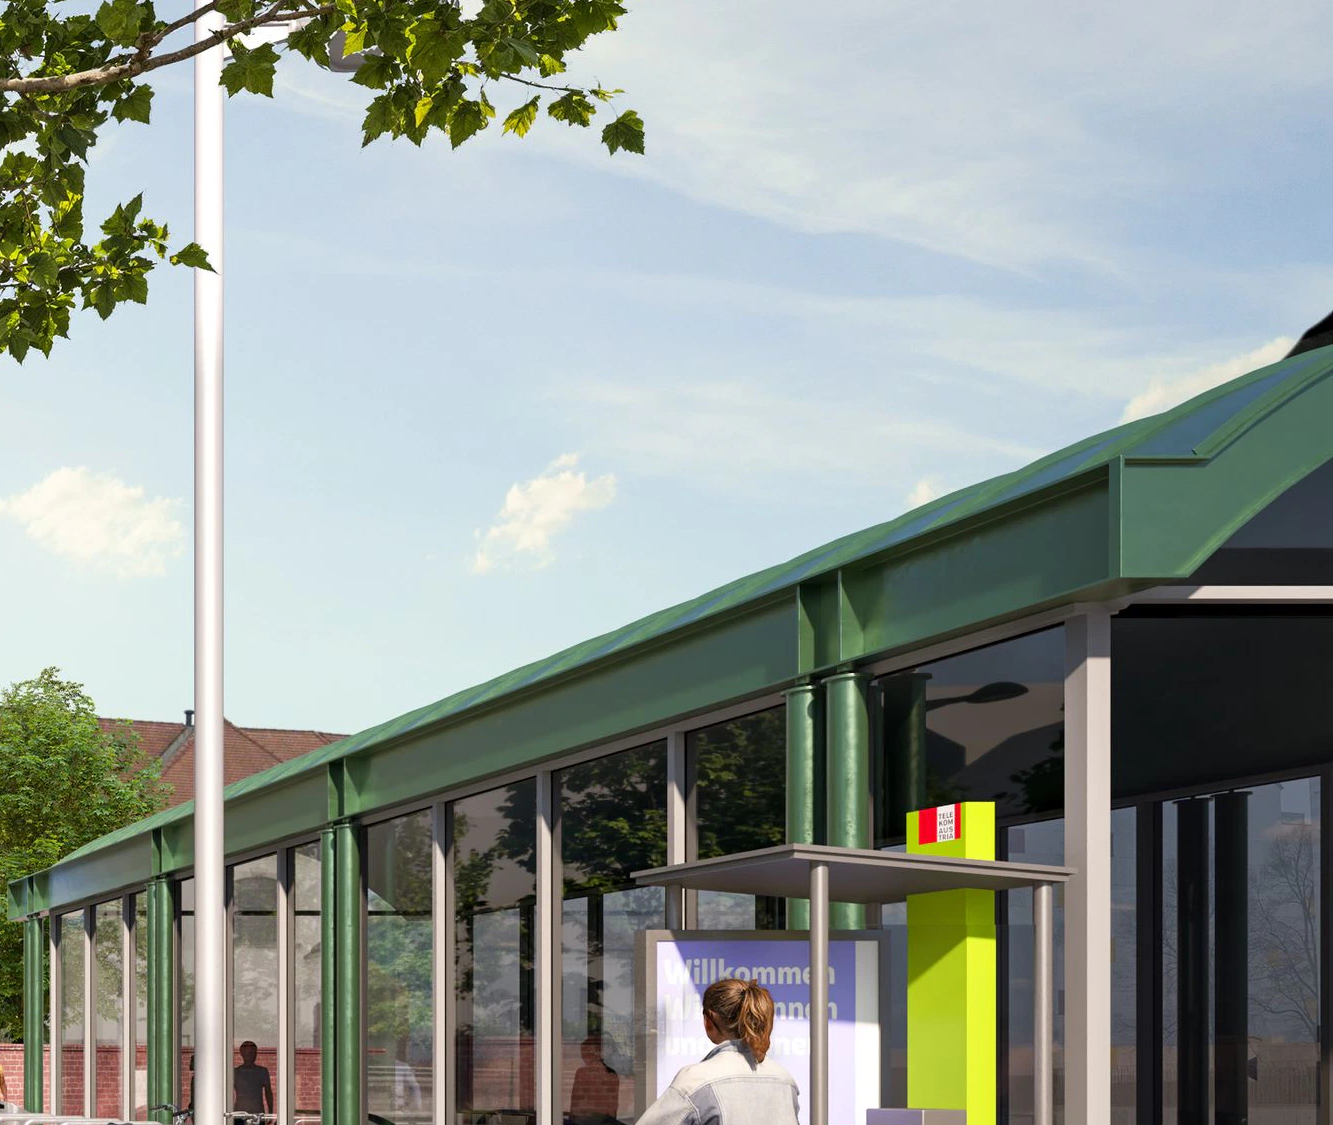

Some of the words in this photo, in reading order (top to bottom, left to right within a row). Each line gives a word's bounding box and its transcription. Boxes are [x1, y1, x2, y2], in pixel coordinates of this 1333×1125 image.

[938, 811, 953, 819] TELE
[938, 819, 953, 827] KOM
[938, 826, 953, 834] AUS
